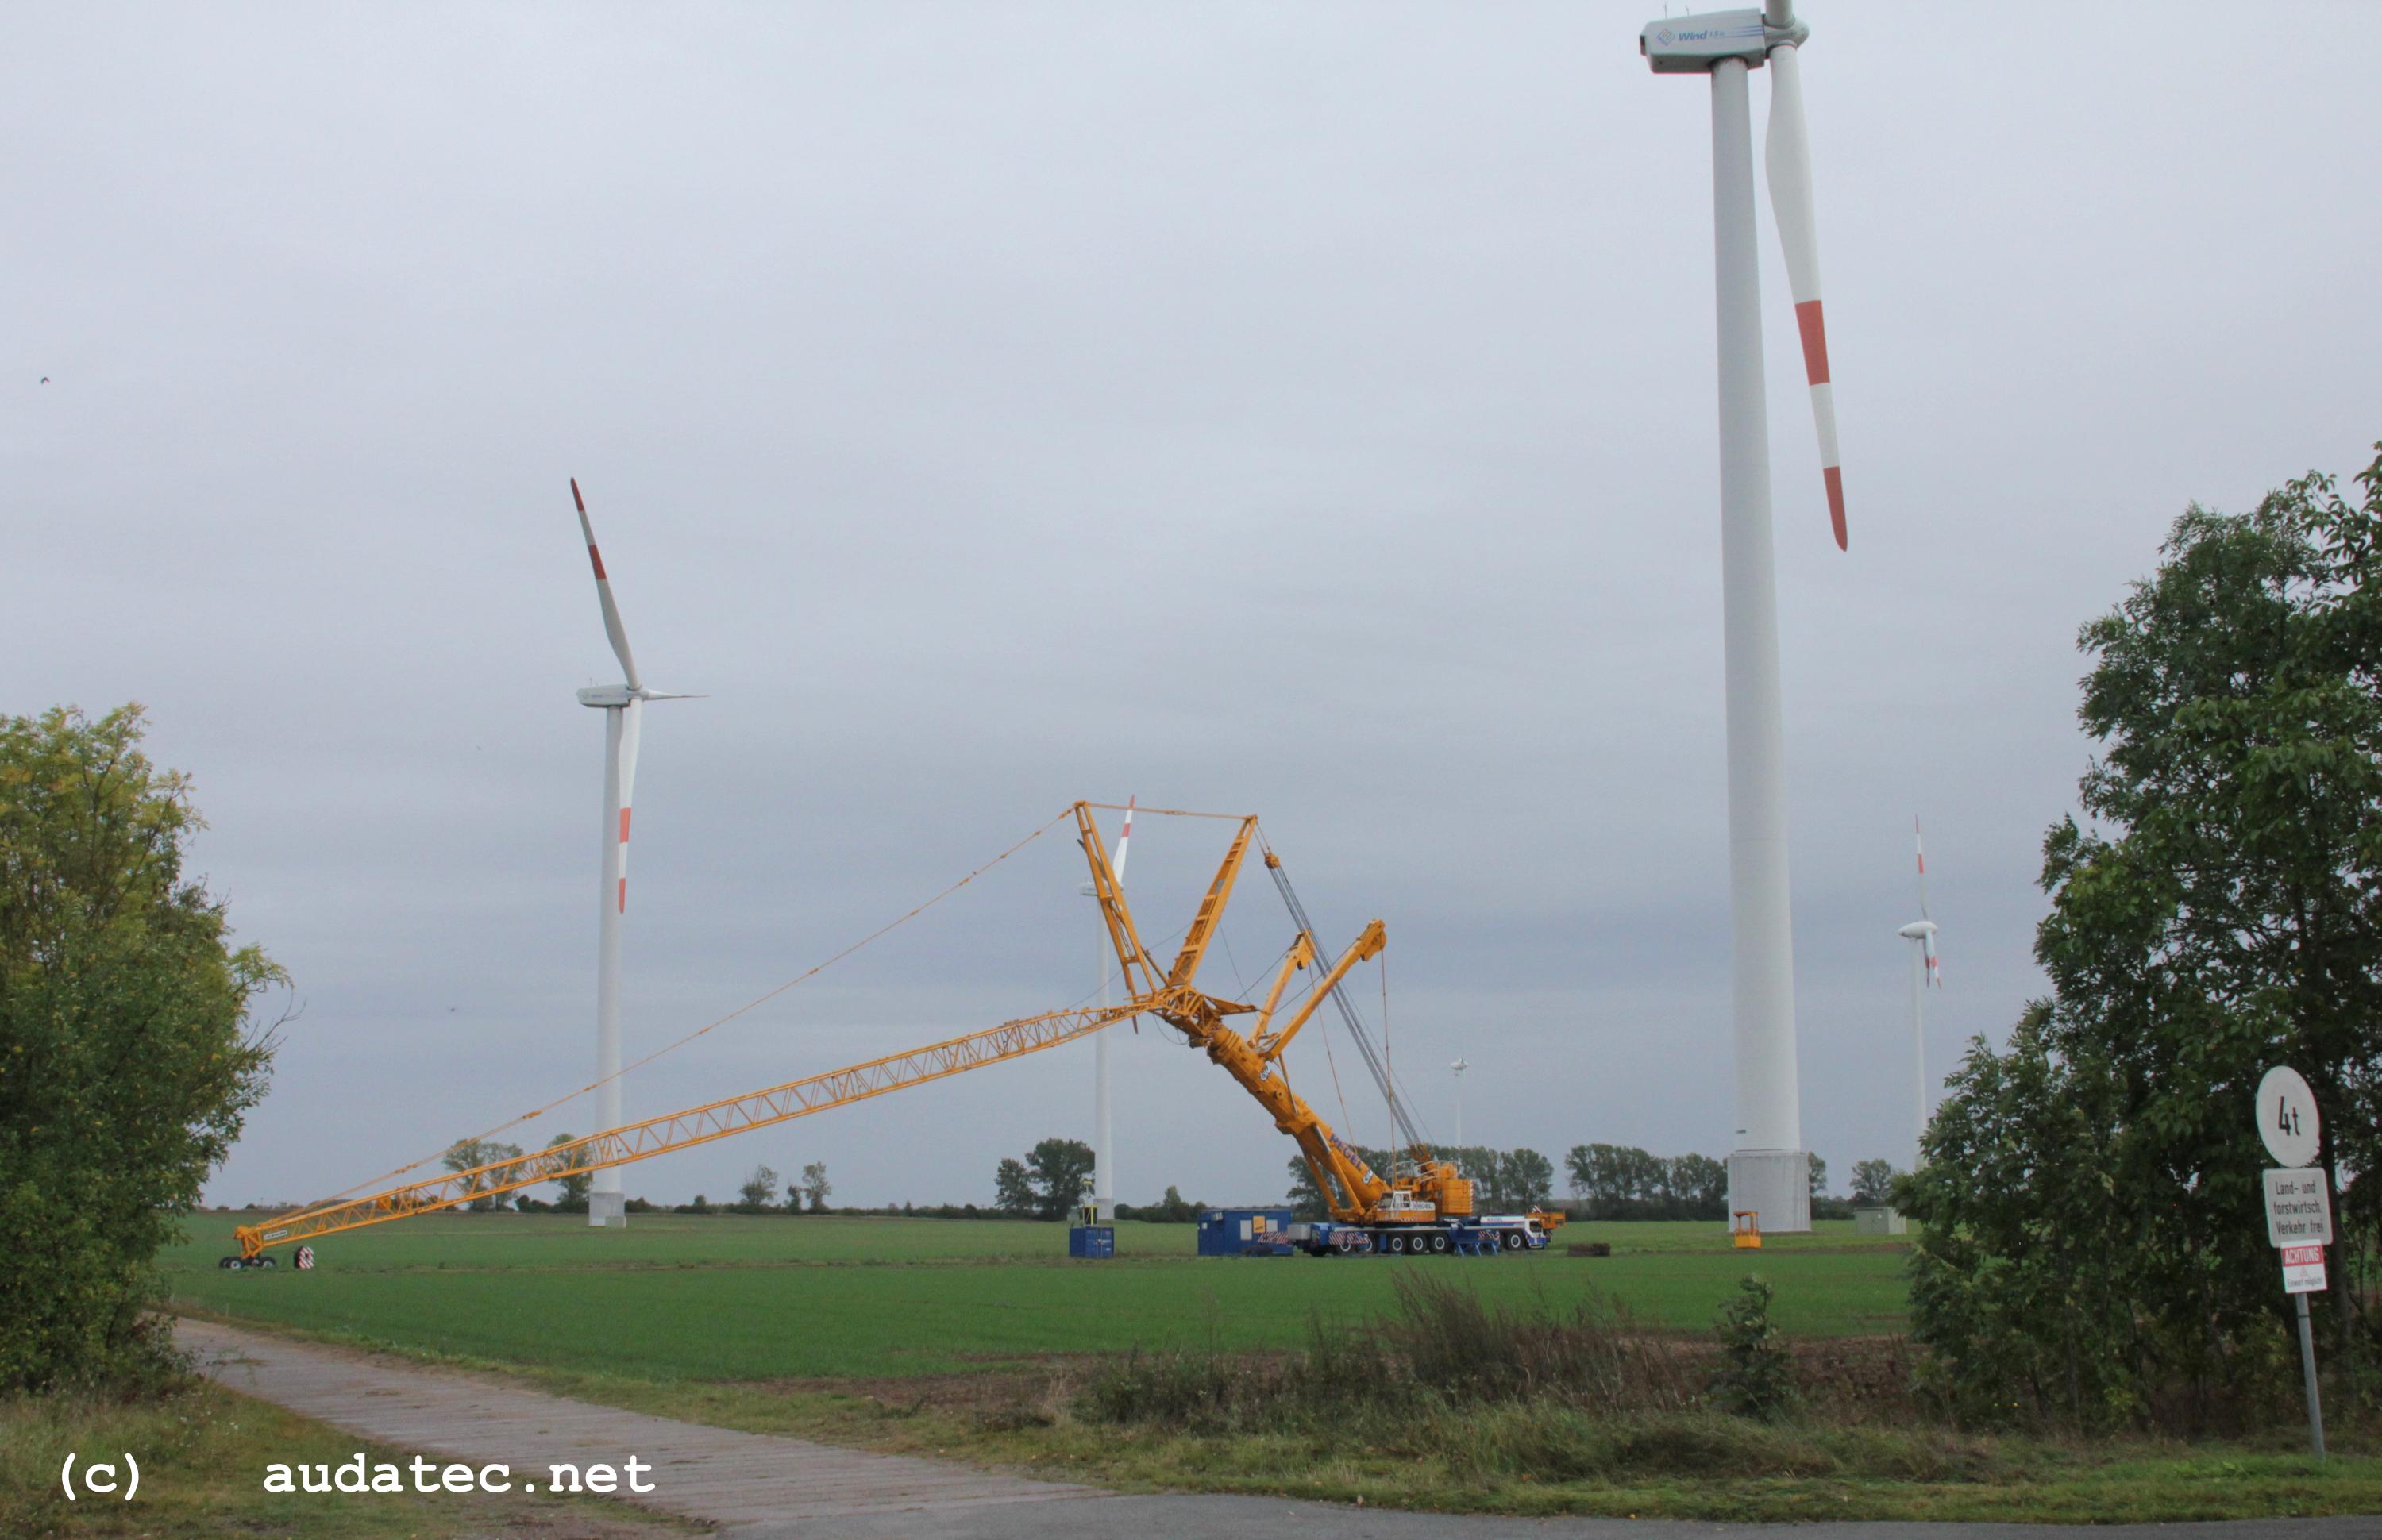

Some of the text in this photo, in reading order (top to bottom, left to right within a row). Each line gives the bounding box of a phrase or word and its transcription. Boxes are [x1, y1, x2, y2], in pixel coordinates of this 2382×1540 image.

[1679, 29, 1708, 41] Wind
[2275, 1179, 2316, 1195] Land- und
[2276, 1219, 2324, 1235] Verkehr frei
[2284, 1246, 2320, 1265] ACHTUNG
